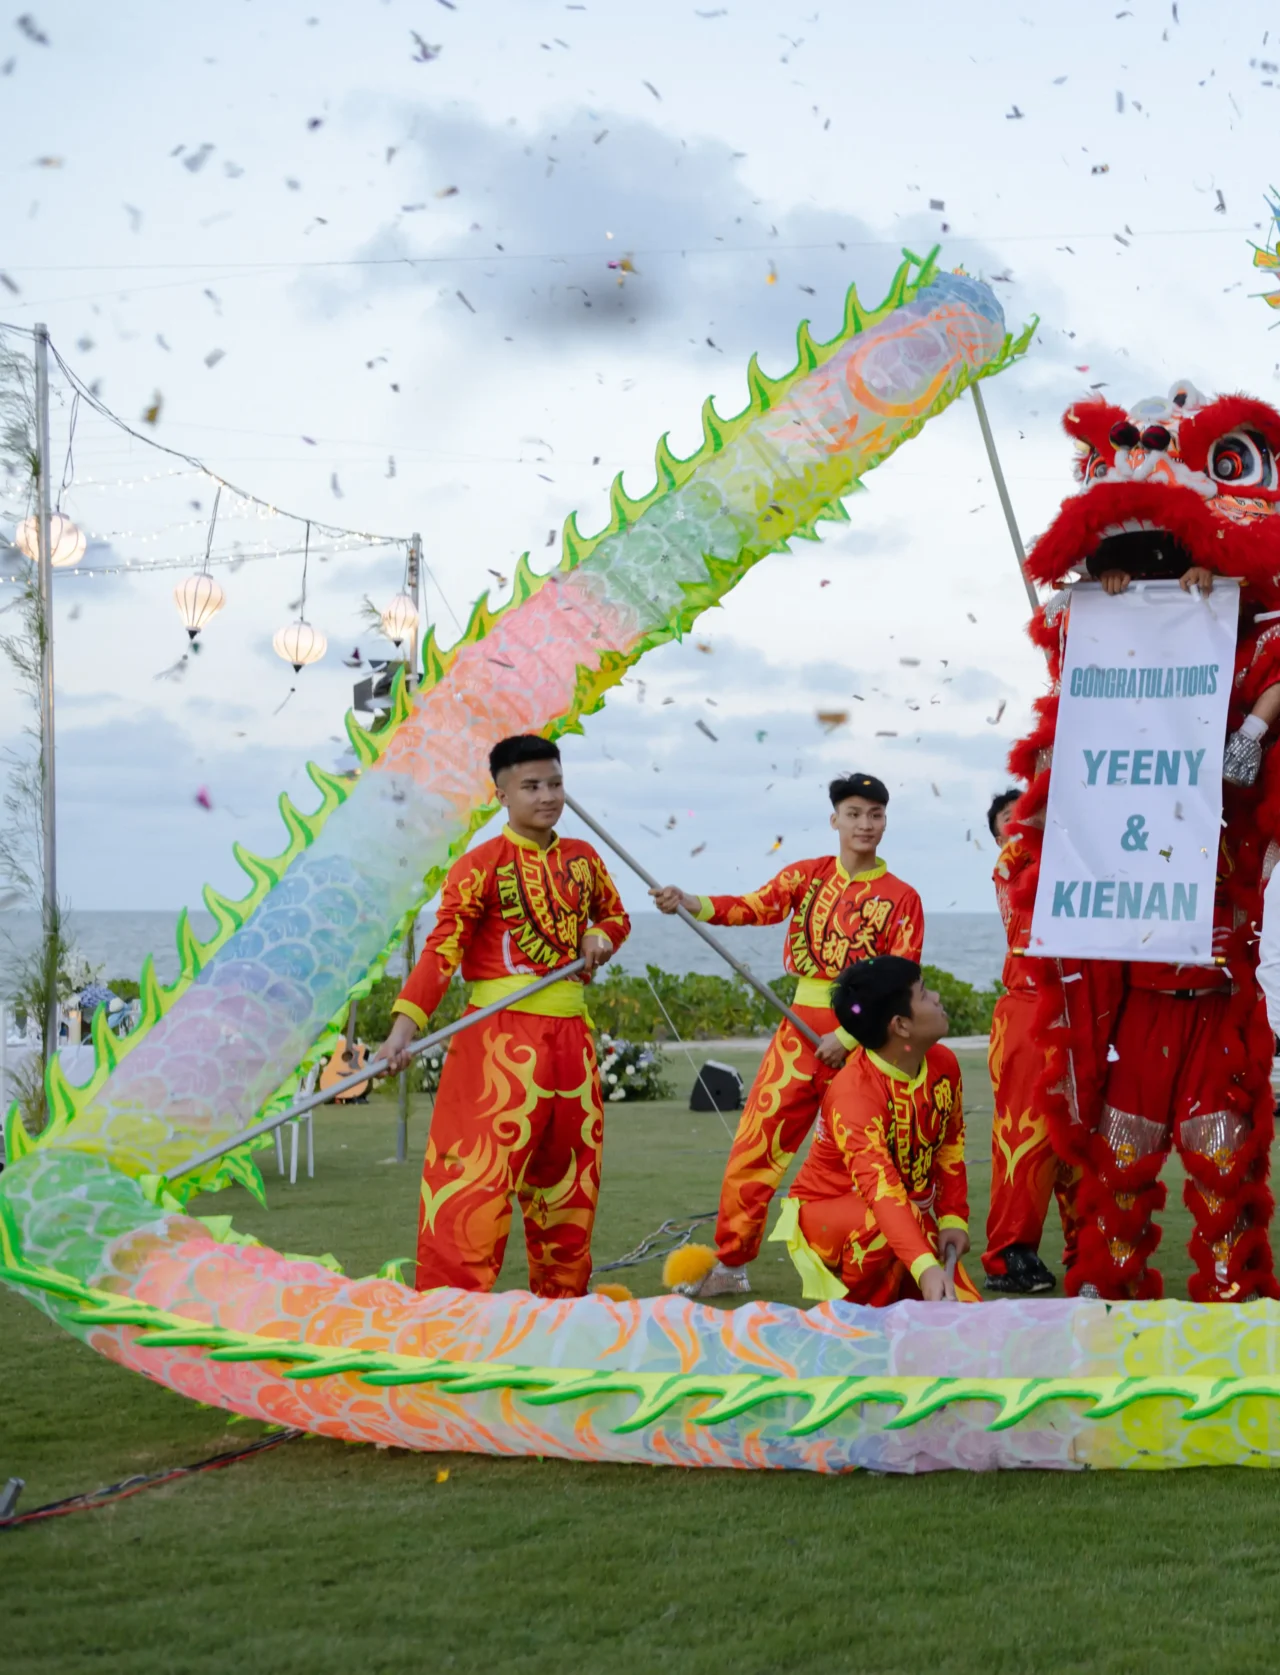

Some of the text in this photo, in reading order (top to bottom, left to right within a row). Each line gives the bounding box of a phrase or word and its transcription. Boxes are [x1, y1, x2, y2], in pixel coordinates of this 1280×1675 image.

[1070, 664, 1219, 698] CONGRATULATIONS
[1083, 749, 1206, 786] YEENY
[1120, 814, 1149, 851] &
[496, 861, 561, 968] VIET NAM
[1051, 881, 1198, 921] KIENAN
